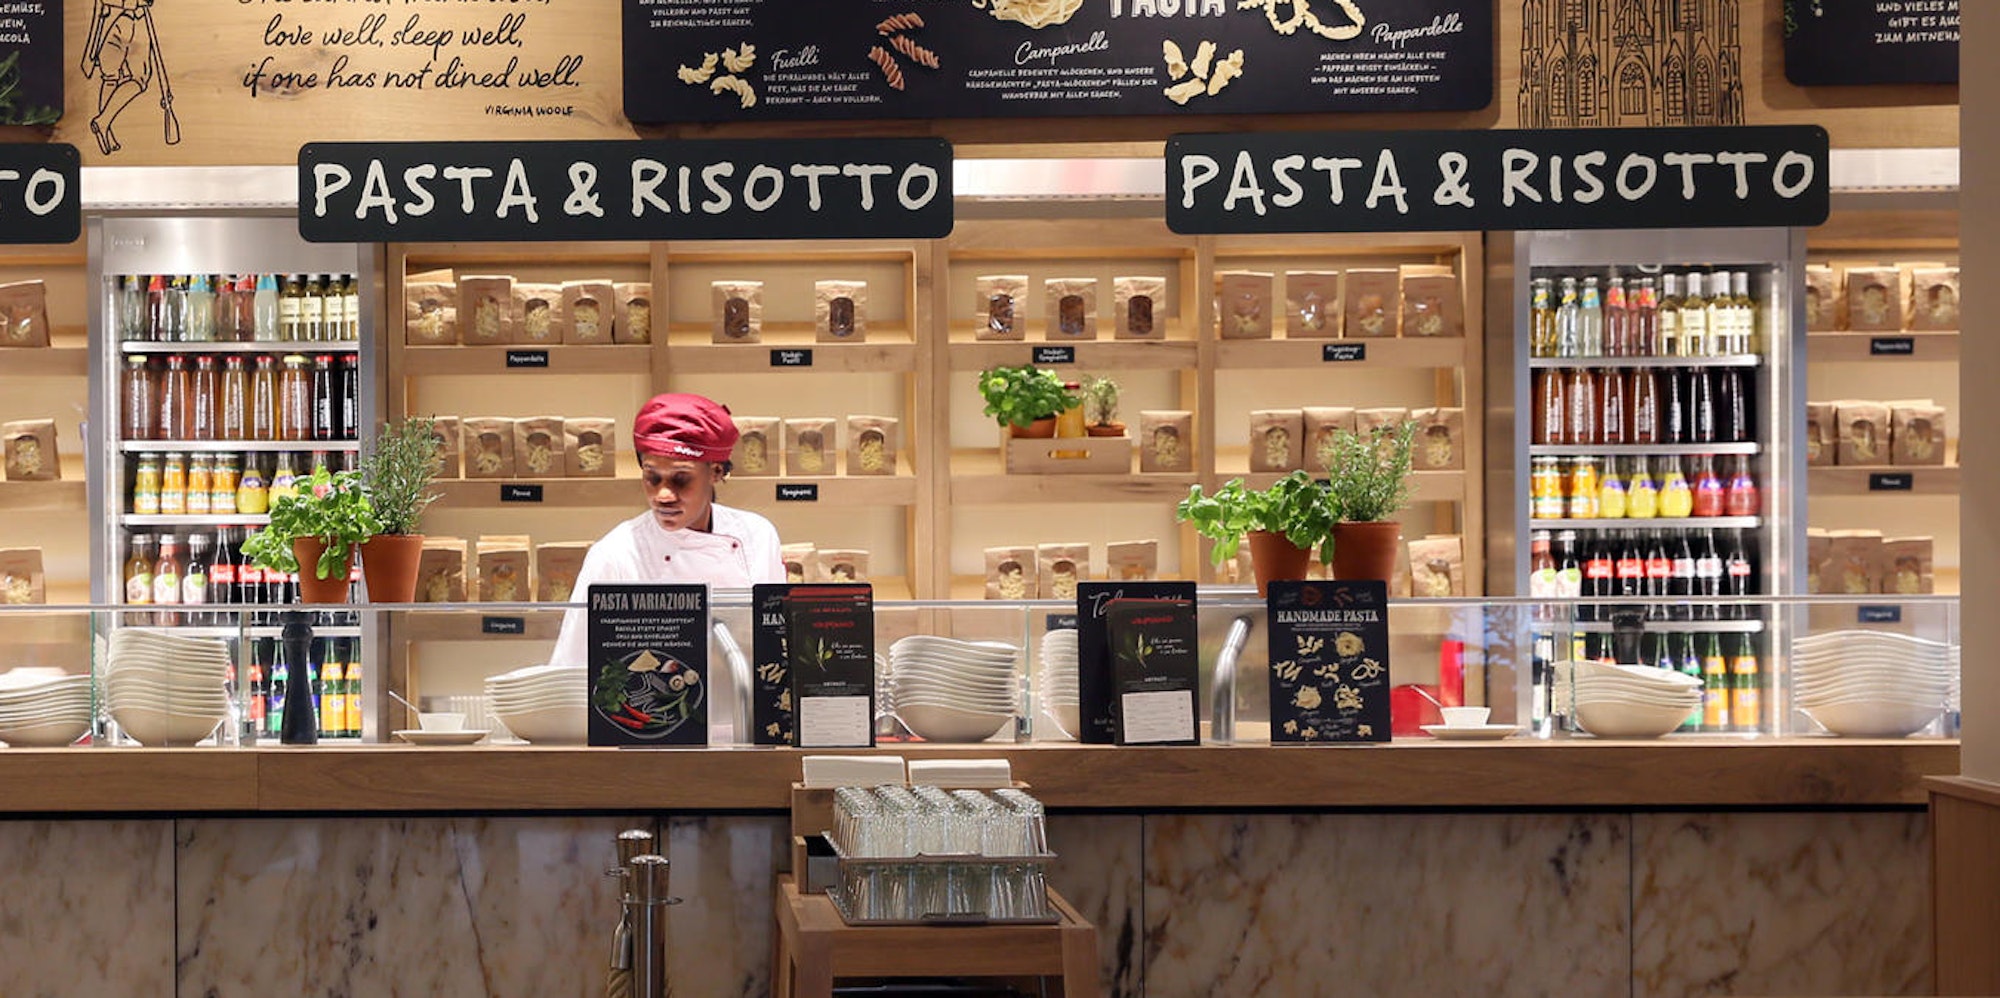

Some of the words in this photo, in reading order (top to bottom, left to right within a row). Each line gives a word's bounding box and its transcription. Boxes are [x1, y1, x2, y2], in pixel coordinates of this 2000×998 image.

[1876, 2, 1901, 13] UND
[1905, 1, 1944, 12] VIELES
[1888, 16, 1918, 27] GIBT
[1921, 16, 1936, 26] ES
[264, 13, 312, 46] love
[322, 13, 387, 47] well,
[391, 13, 453, 61] sleep
[462, 12, 526, 47] well,
[1371, 13, 1464, 50] Pappardelle
[1875, 32, 1902, 43] ZUM
[1014, 31, 1109, 65] Campanelle
[770, 45, 820, 72] Fusilli
[1407, 52, 1424, 60] ALLE
[242, 56, 274, 97] if
[271, 72, 317, 88] one
[326, 55, 376, 89] has
[383, 61, 432, 89] not
[435, 56, 518, 88] dined
[518, 55, 583, 88] well.
[968, 69, 1016, 77] CAMPANELLE
[1344, 75, 1376, 83] MACHEN
[1051, 91, 1064, 99] MIT
[485, 105, 533, 118] VIRGINIA
[537, 106, 574, 116] WOOLF
[1180, 149, 1409, 215] PASTA
[1433, 151, 1475, 208] &
[1501, 148, 1815, 206] RISOTTO
[313, 158, 538, 224] PASTA
[563, 160, 604, 217] &
[631, 158, 939, 216] RISOTTO
[592, 593, 629, 611] PASTA
[632, 593, 702, 611] VARIAZIONE
[1277, 611, 1342, 623] HANDMADE
[1343, 610, 1379, 622] PASTA
